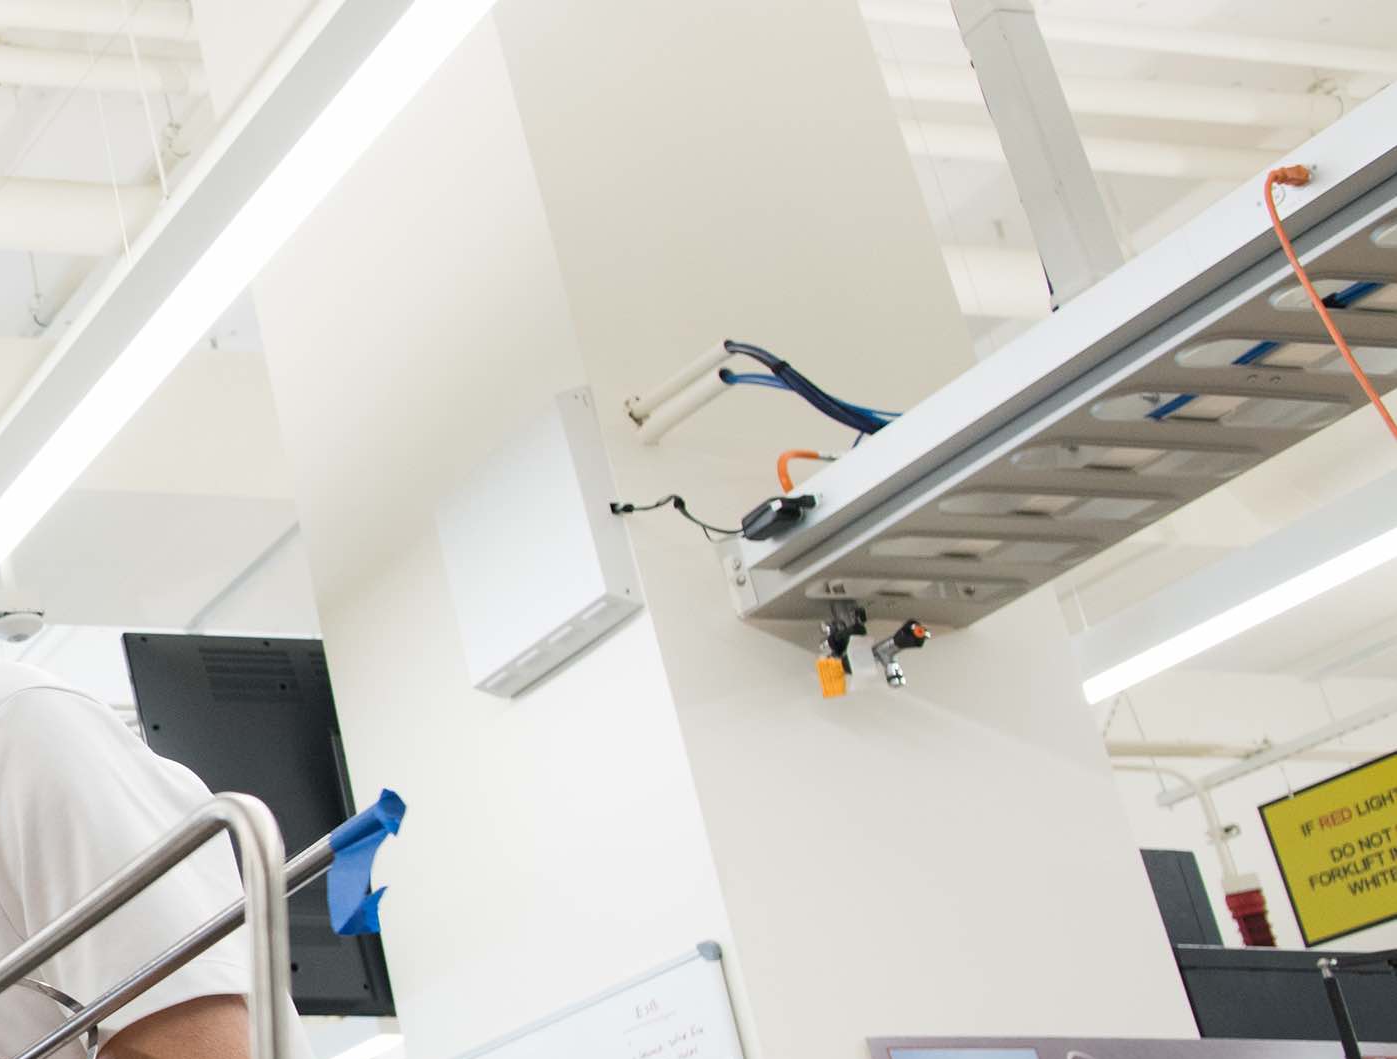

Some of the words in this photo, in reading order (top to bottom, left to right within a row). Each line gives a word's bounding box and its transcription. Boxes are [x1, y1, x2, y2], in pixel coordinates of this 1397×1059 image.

[1301, 820, 1313, 838] IF
[1318, 806, 1353, 831] RED
[1330, 842, 1356, 863] DO
[1358, 826, 1392, 852] NOT
[1308, 850, 1384, 892] FORKLIFT
